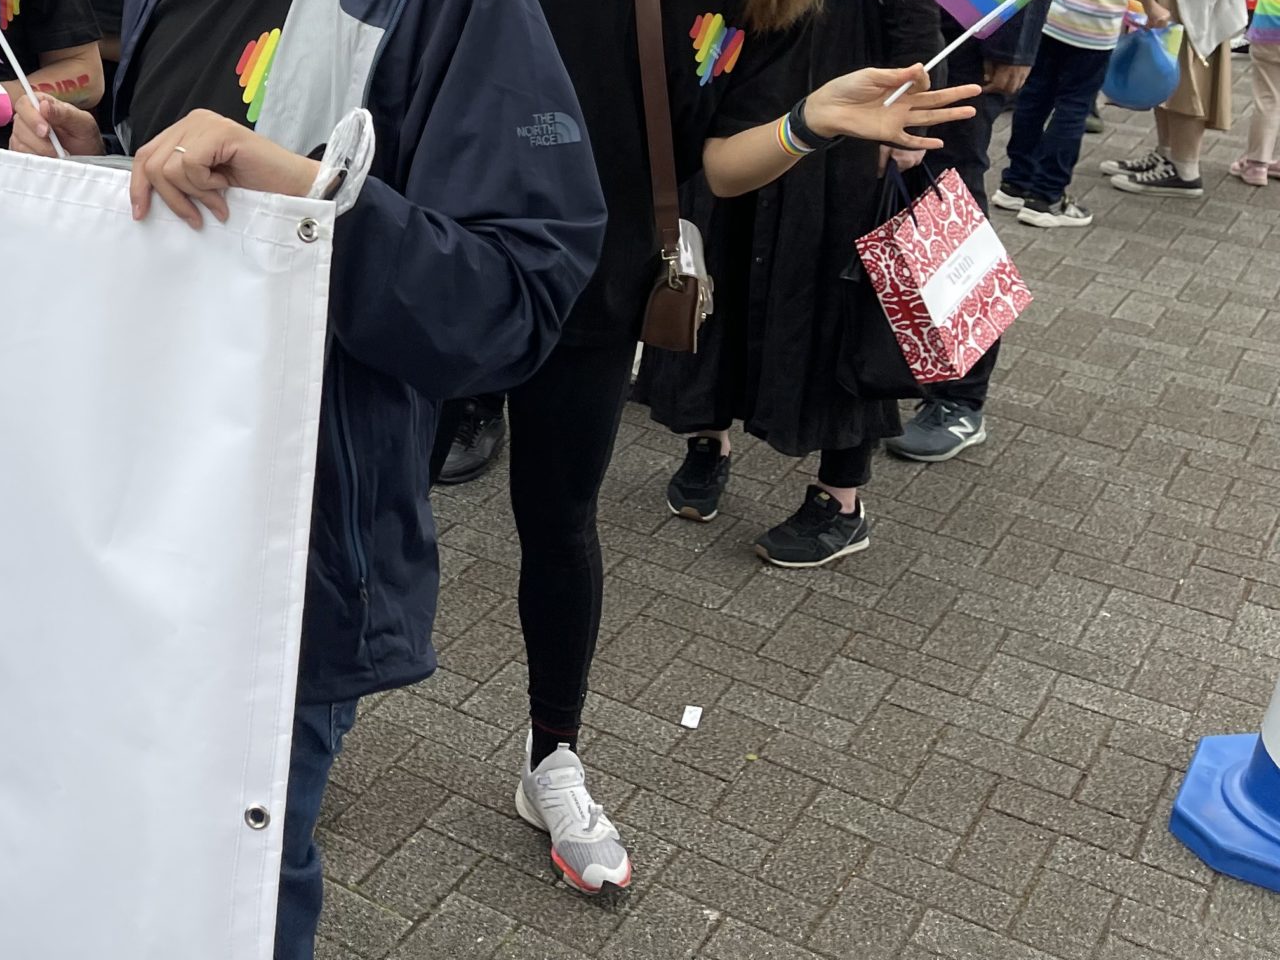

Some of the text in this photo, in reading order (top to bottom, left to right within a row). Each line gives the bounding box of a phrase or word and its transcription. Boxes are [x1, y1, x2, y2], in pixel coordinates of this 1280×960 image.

[532, 112, 555, 125] THE
[517, 124, 554, 138] NORTH
[530, 134, 557, 146] FACE
